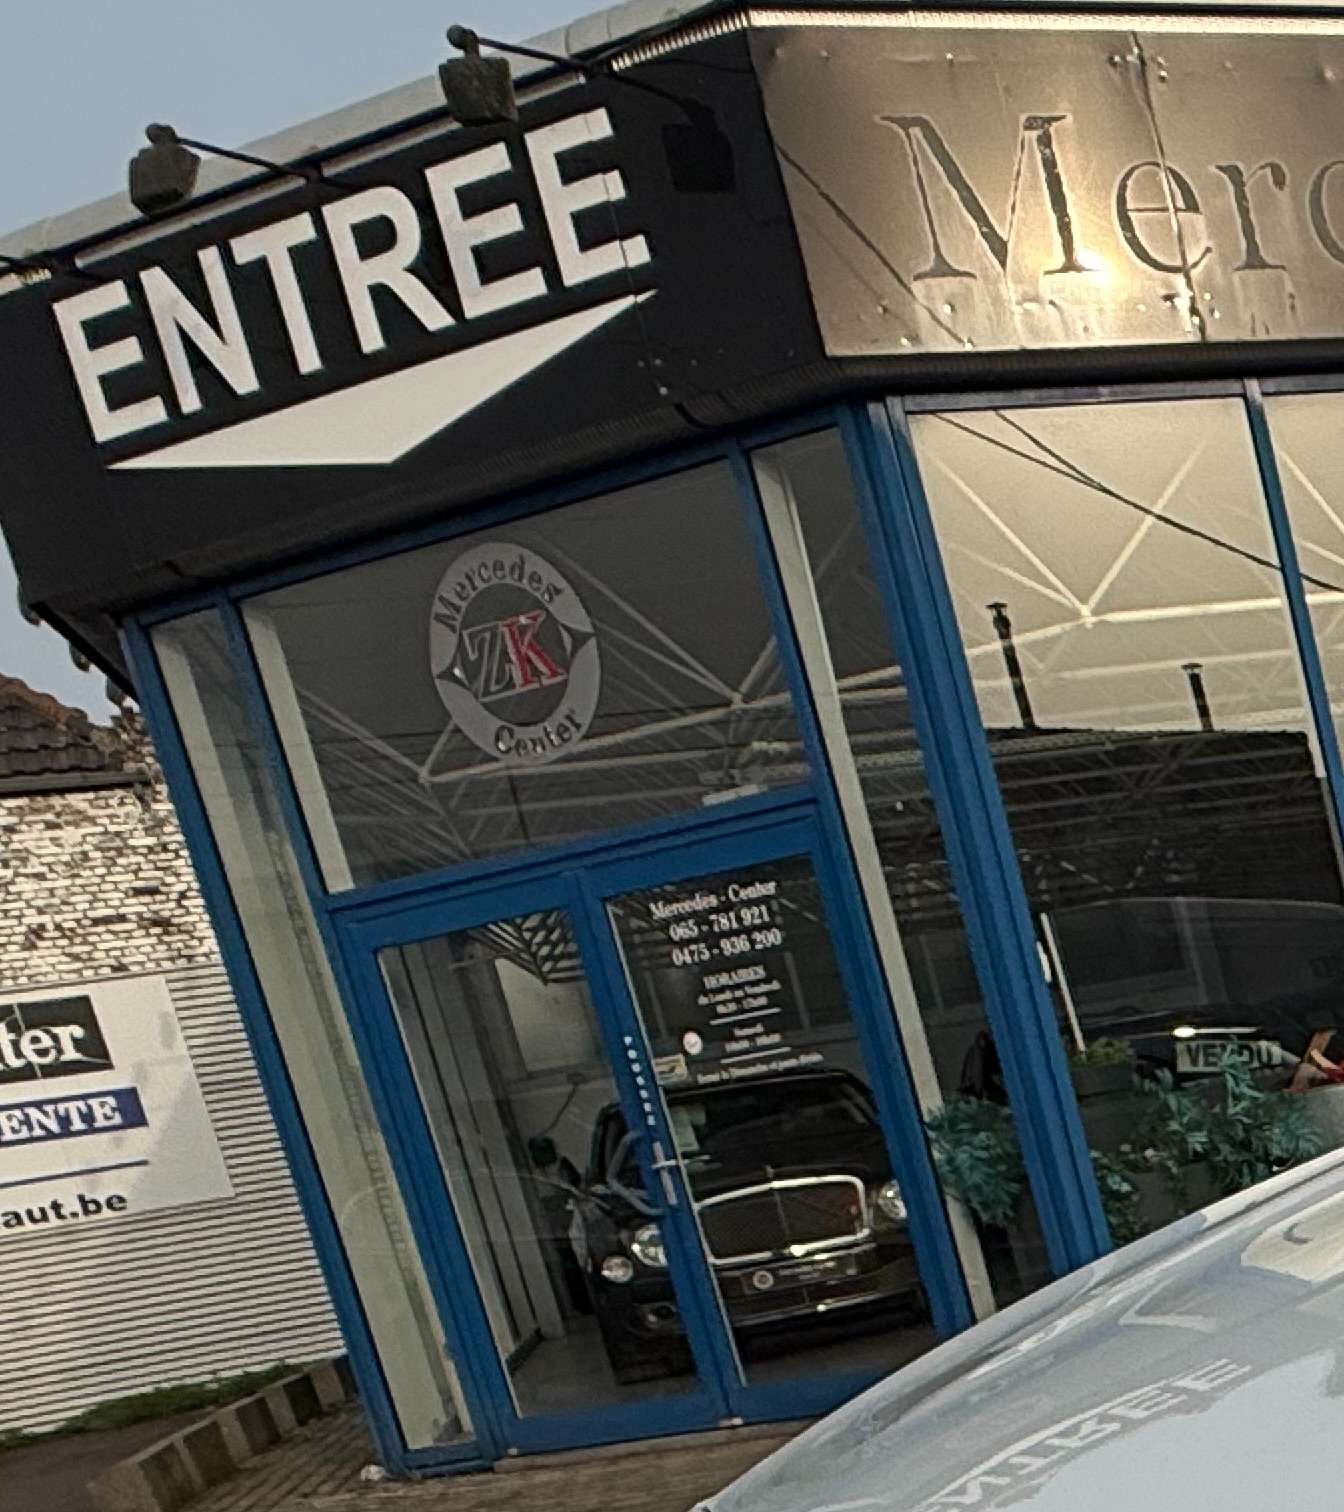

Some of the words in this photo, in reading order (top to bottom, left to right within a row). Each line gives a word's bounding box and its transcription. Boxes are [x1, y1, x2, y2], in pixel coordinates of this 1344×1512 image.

[53, 107, 651, 444] ENTREE
[434, 555, 562, 634] Mercedes
[494, 708, 583, 756] Center
[0, 1096, 123, 1141] ENTE
[0, 1194, 128, 1228] aut.be
